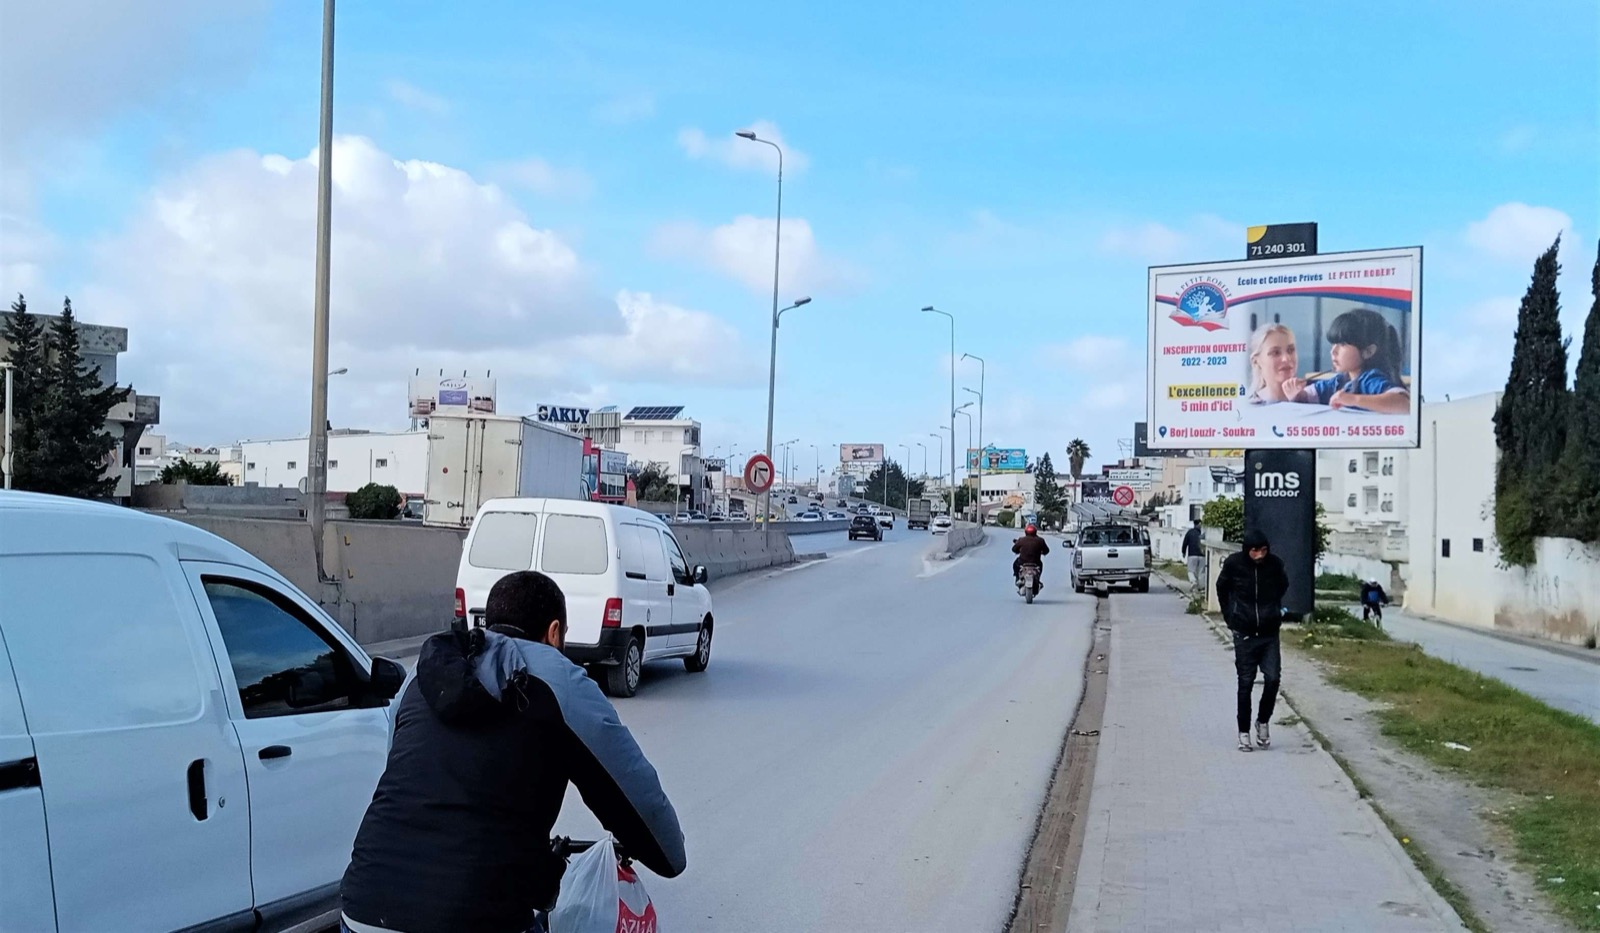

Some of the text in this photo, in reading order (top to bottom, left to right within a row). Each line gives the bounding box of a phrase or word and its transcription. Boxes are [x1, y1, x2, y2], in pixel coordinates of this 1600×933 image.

[1251, 243, 1306, 256] 71 240 301
[1237, 267, 1396, 286] École et Collège Privés LE PETIT ROBERT
[1163, 343, 1247, 355] INSCRIPTION OUVERTE
[1181, 357, 1201, 367] 2022
[1207, 356, 1227, 366] 2023
[1168, 384, 1246, 397] L'excellence à
[1181, 400, 1232, 412] 5 min d'ici
[1170, 427, 1188, 438] Borj
[1190, 427, 1216, 437] Louzir
[1222, 427, 1255, 437] Soukra
[1286, 426, 1299, 437] 55
[1301, 426, 1320, 436] 505
[1322, 426, 1340, 436] 001
[1347, 426, 1360, 436] 54
[1362, 426, 1381, 436] 555
[1384, 425, 1404, 436] 666
[1254, 462, 1300, 489] ims
[1254, 489, 1300, 498] outdoor
